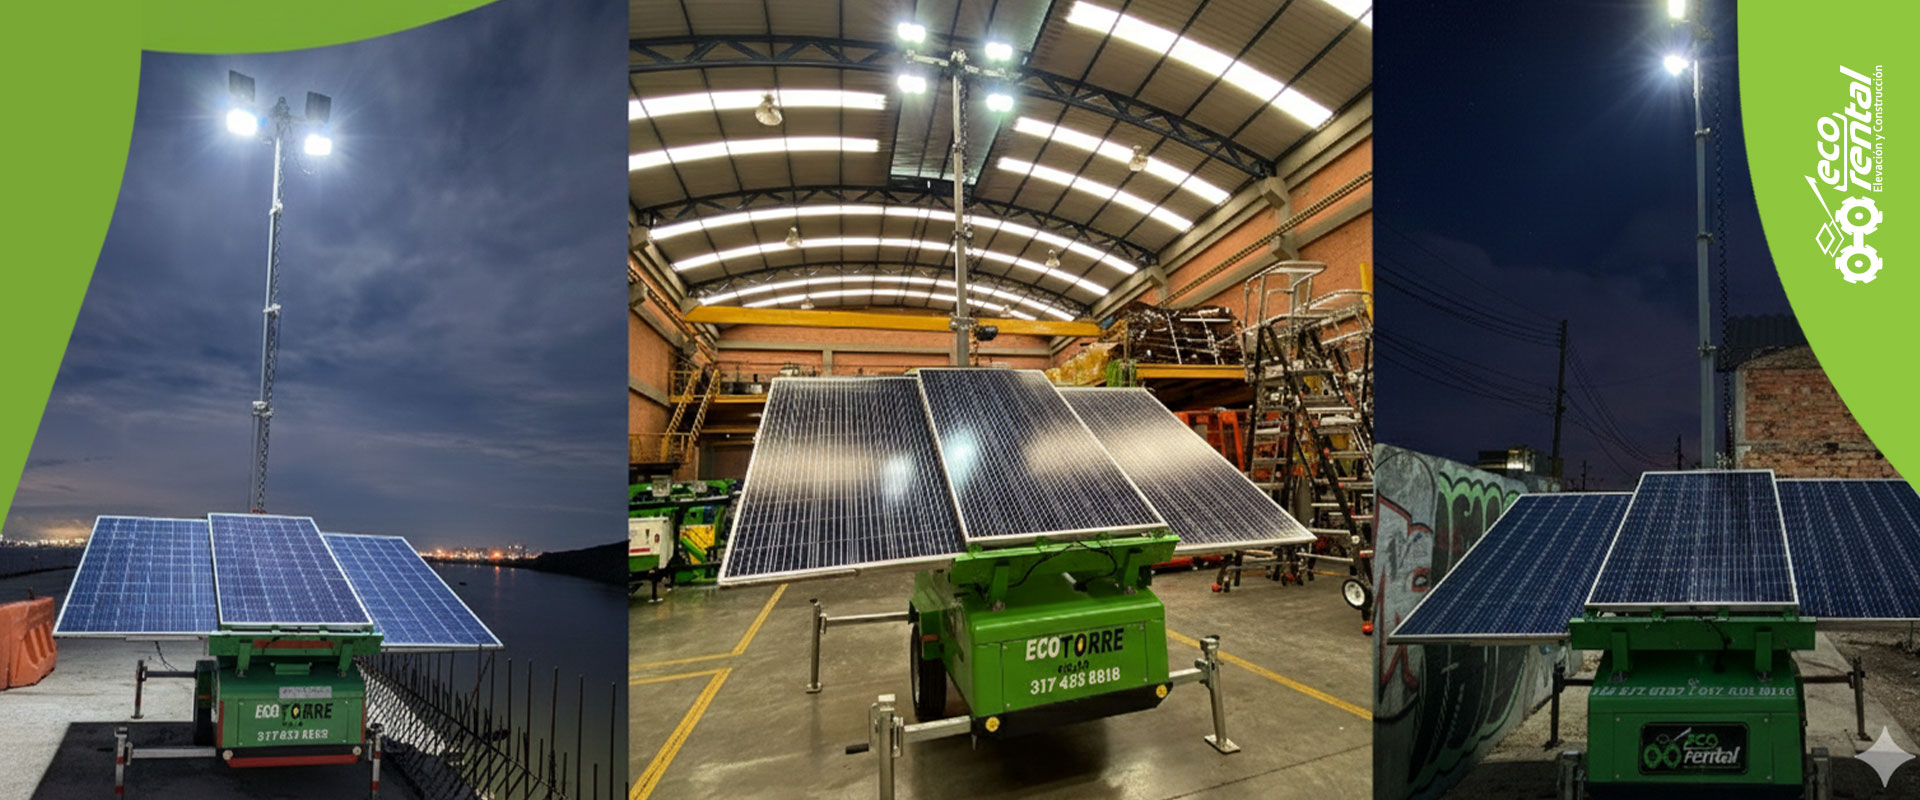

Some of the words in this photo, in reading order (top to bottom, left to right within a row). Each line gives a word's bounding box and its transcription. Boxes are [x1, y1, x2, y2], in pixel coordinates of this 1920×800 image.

[1025, 628, 1124, 661] ECOTORRE
[1030, 676, 1057, 695] 317
[1088, 666, 1121, 685] 8818
